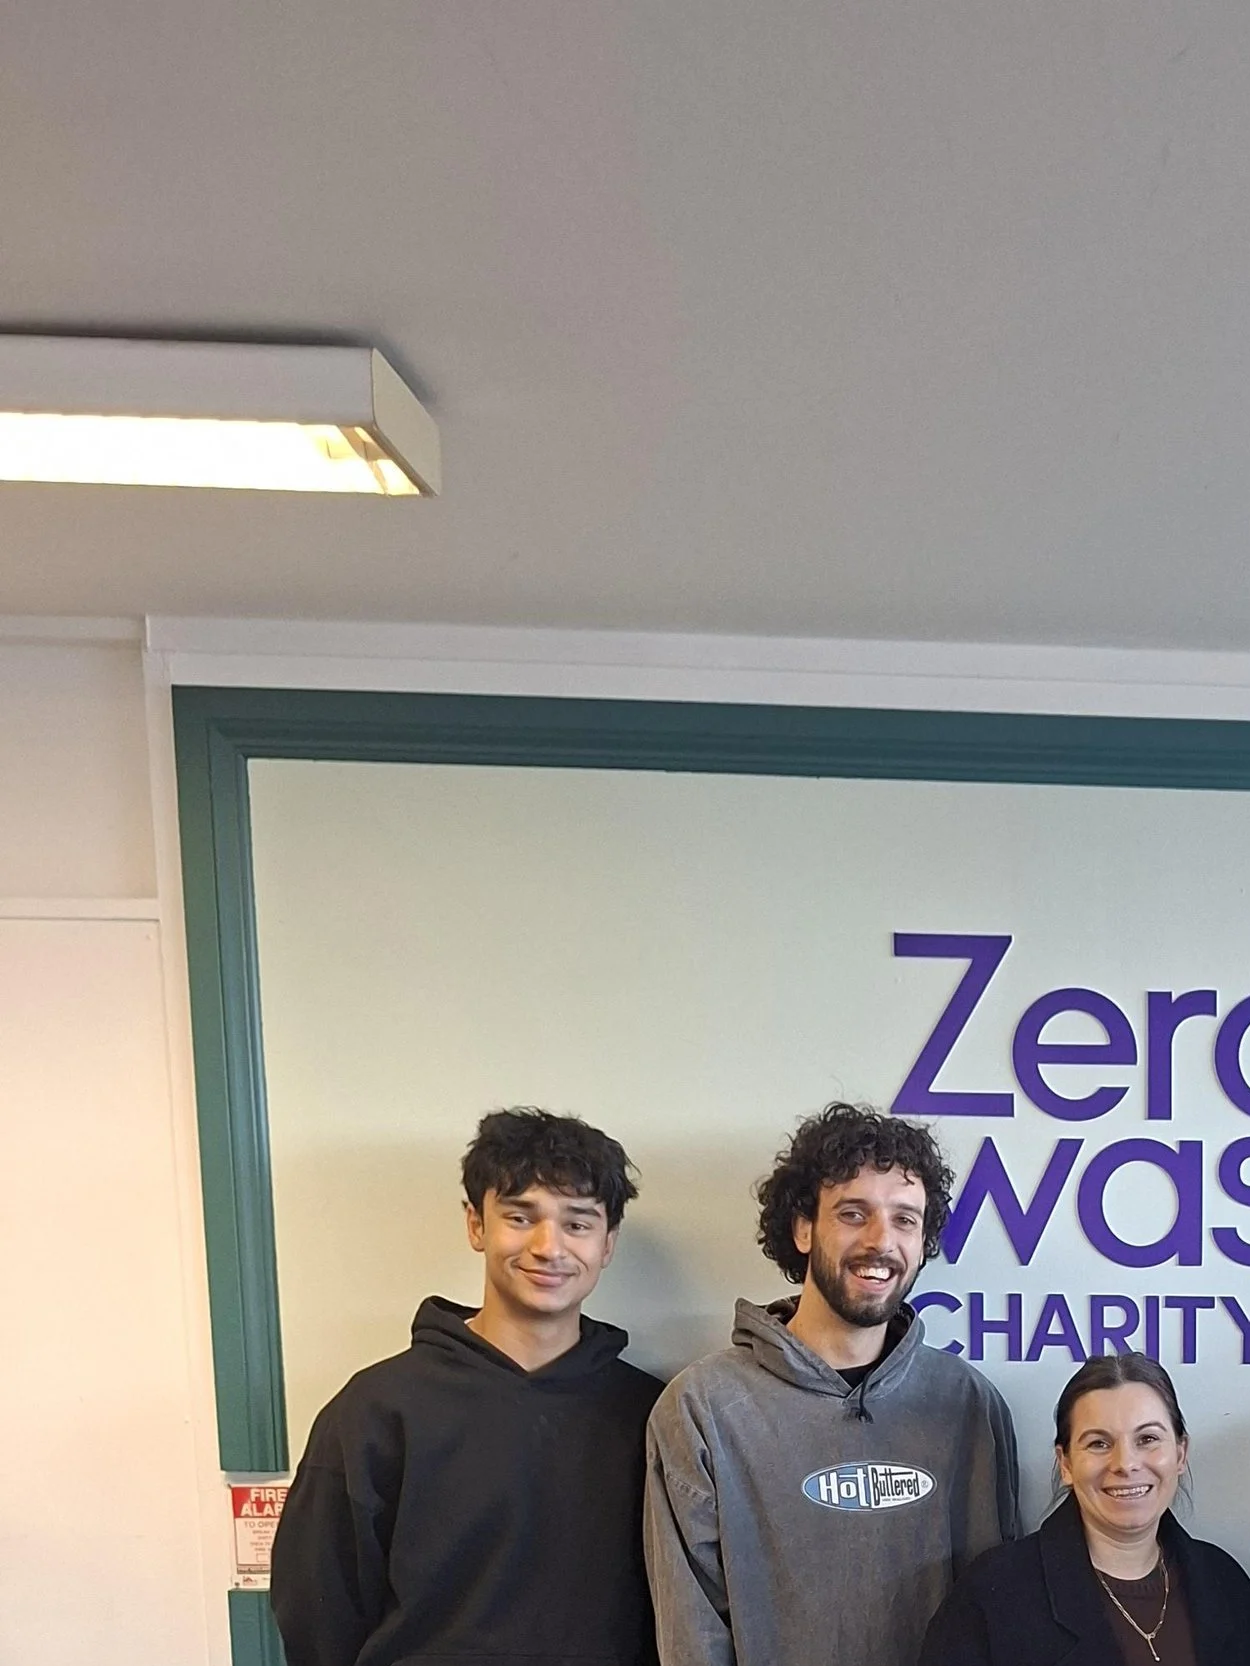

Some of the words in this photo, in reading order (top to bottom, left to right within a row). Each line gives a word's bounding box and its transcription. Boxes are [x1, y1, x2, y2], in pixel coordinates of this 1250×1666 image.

[818, 1467, 870, 1507] Hot
[871, 1467, 920, 1506] Buttered
[250, 1488, 287, 1502] FIRE
[240, 1503, 284, 1517] ALAR
